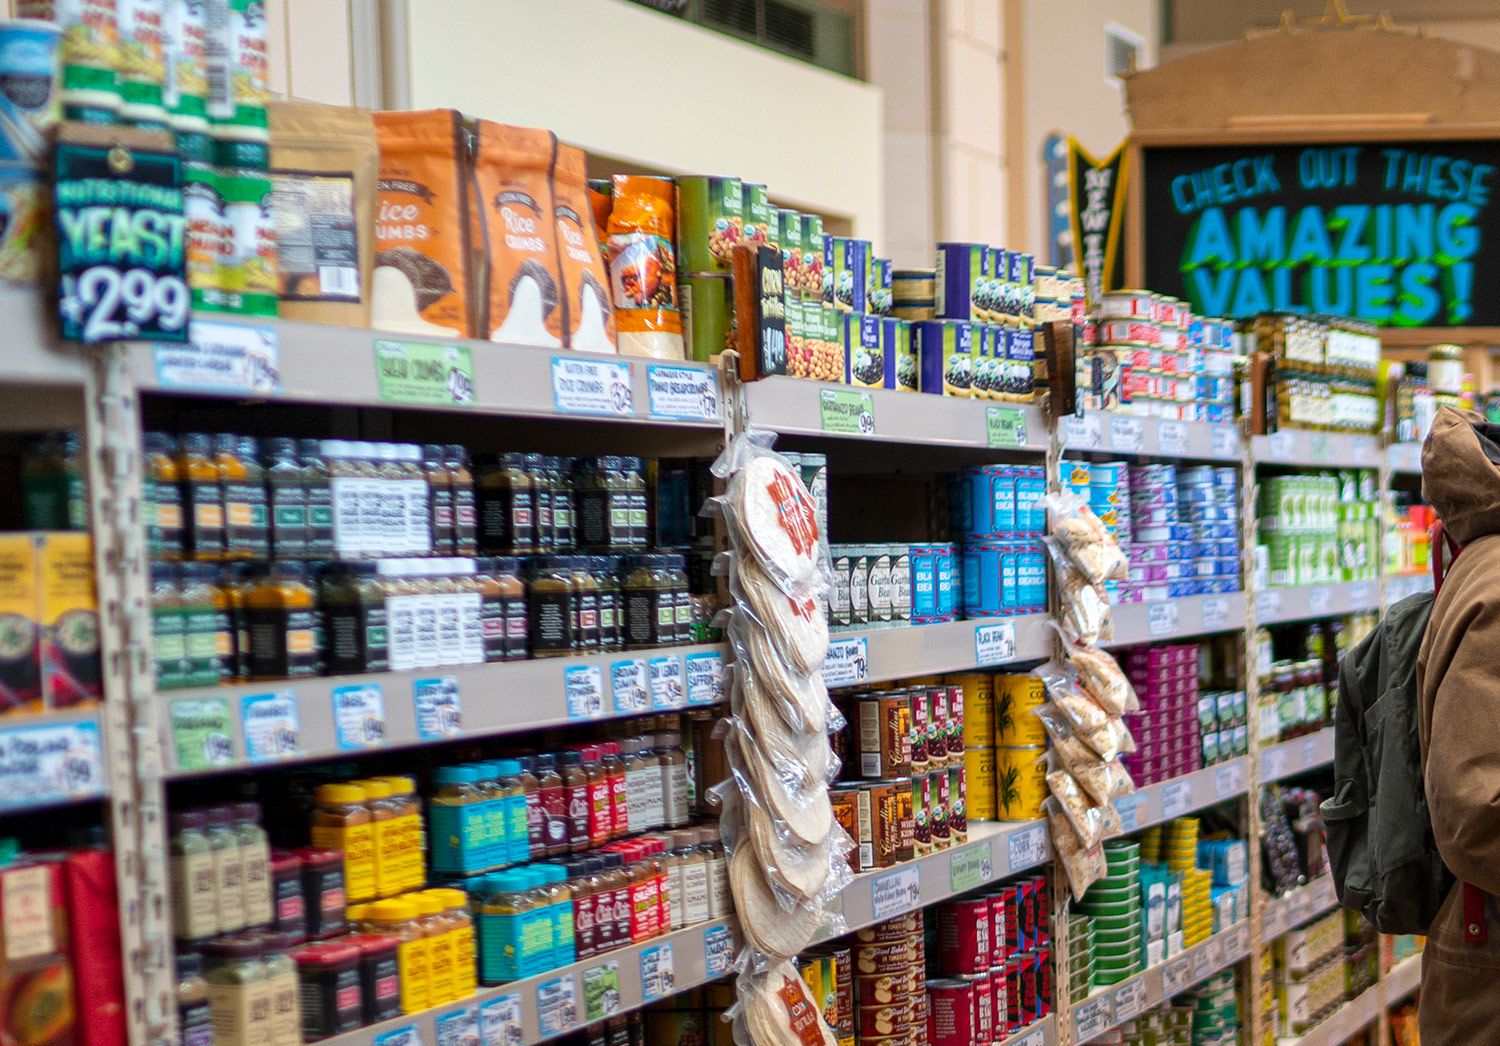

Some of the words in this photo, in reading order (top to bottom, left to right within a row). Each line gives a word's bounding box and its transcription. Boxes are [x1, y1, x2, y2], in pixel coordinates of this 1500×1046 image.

[1171, 153, 1280, 214] CHECK
[1301, 148, 1362, 189] OUT
[1383, 149, 1496, 206] THESE
[58, 207, 186, 262] YEAST
[501, 207, 534, 233] Rice
[1186, 203, 1482, 268] AMAZING
[60, 267, 190, 343] $2.99
[1192, 262, 1474, 326] VALUES!
[889, 709, 901, 766] Cannellini
[880, 799, 892, 855] Cannellini
